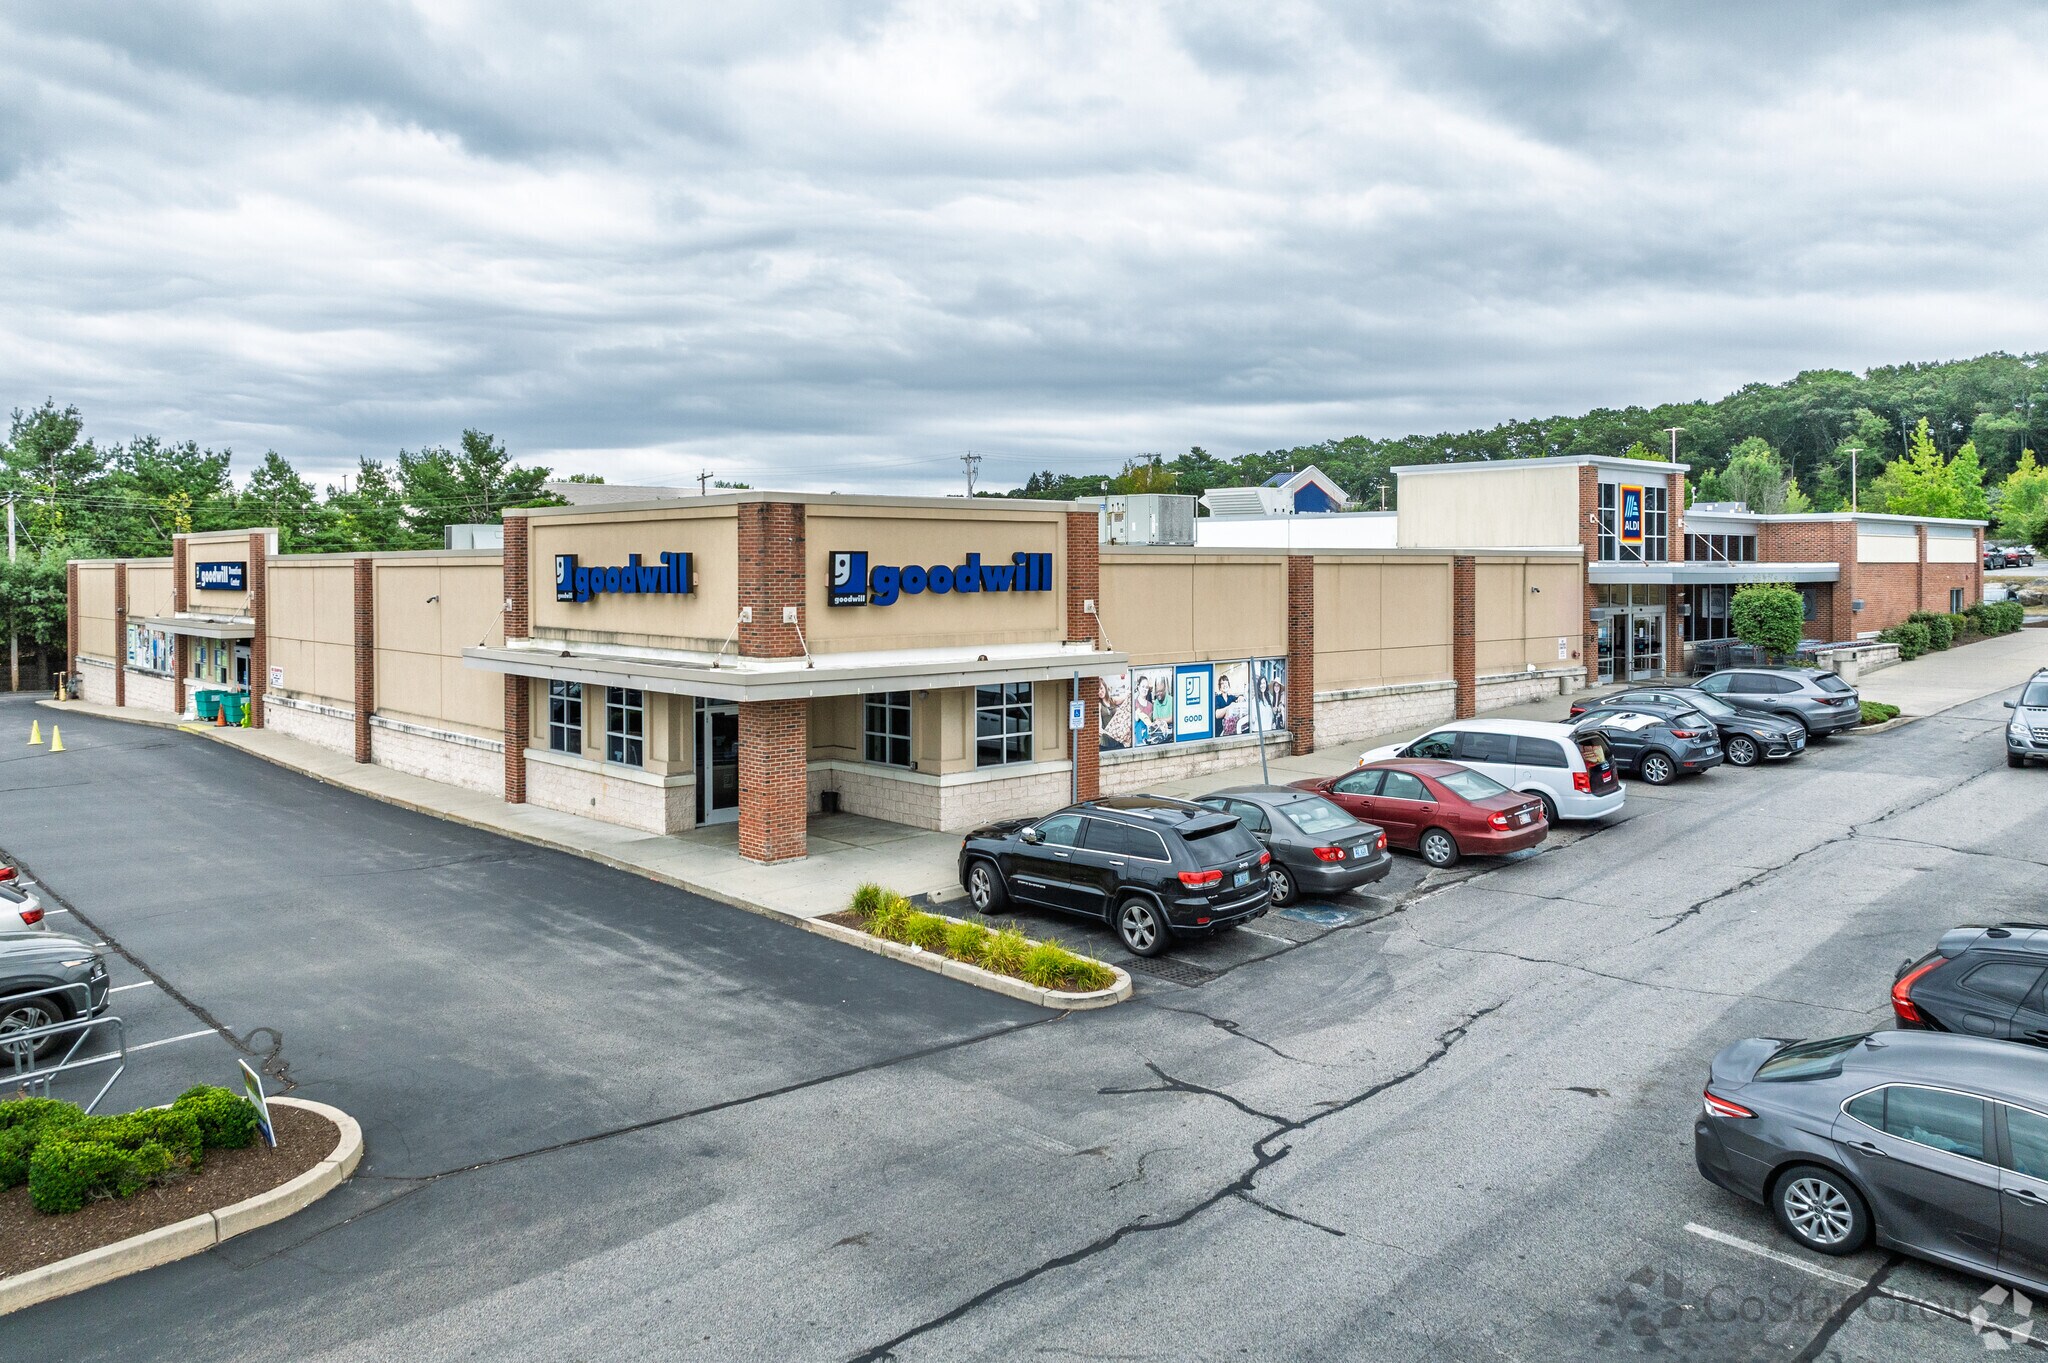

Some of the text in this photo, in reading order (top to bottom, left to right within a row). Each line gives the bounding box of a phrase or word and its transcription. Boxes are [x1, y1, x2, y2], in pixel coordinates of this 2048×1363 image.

[1624, 520, 1640, 531] ALDI
[201, 565, 229, 587] goodwill
[575, 551, 693, 603] goodwill
[869, 551, 1053, 606] goodwill
[834, 594, 866, 605] goodwill
[1183, 714, 1203, 723] GOOD
